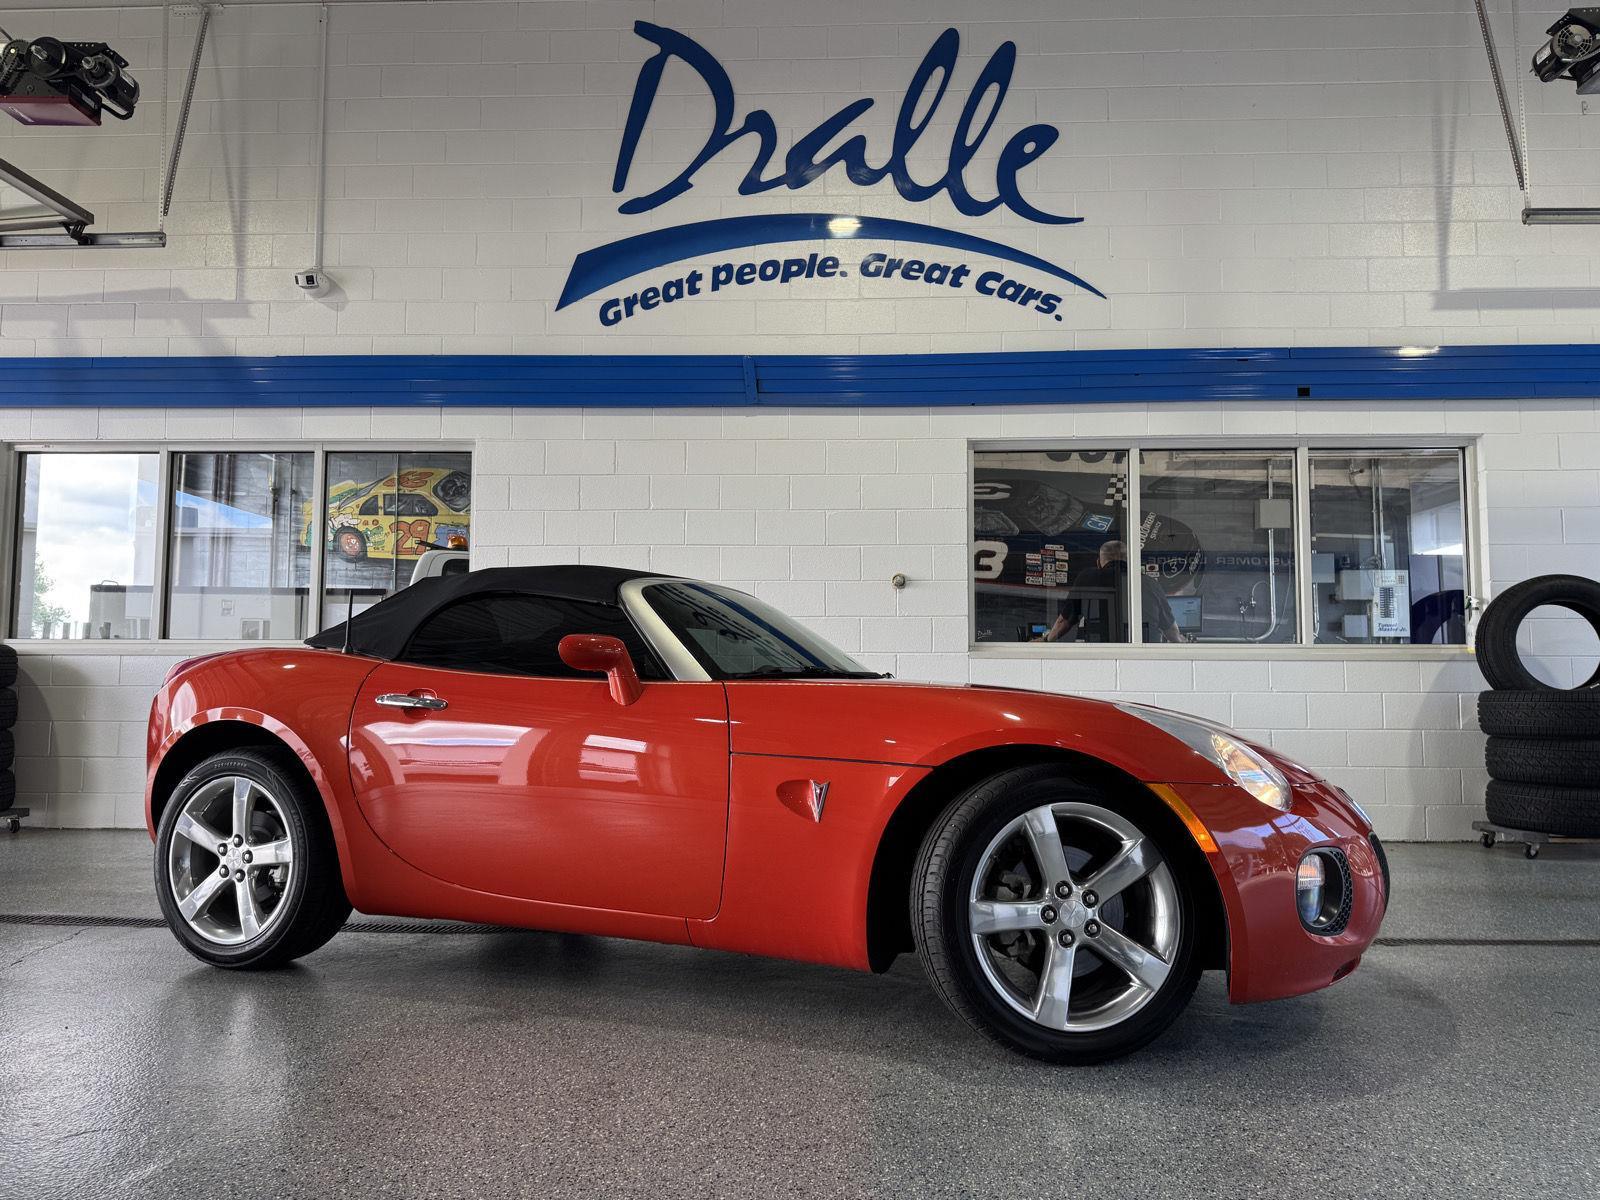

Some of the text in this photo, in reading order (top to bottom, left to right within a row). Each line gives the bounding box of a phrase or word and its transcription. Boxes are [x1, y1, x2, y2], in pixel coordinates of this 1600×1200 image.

[612, 20, 1084, 225] Dralle
[599, 273, 703, 327] Great
[860, 252, 970, 290] Great
[975, 269, 1064, 322] Cars.
[389, 519, 432, 556] 29
[1087, 513, 1111, 531] GM
[974, 540, 1009, 579] 3
